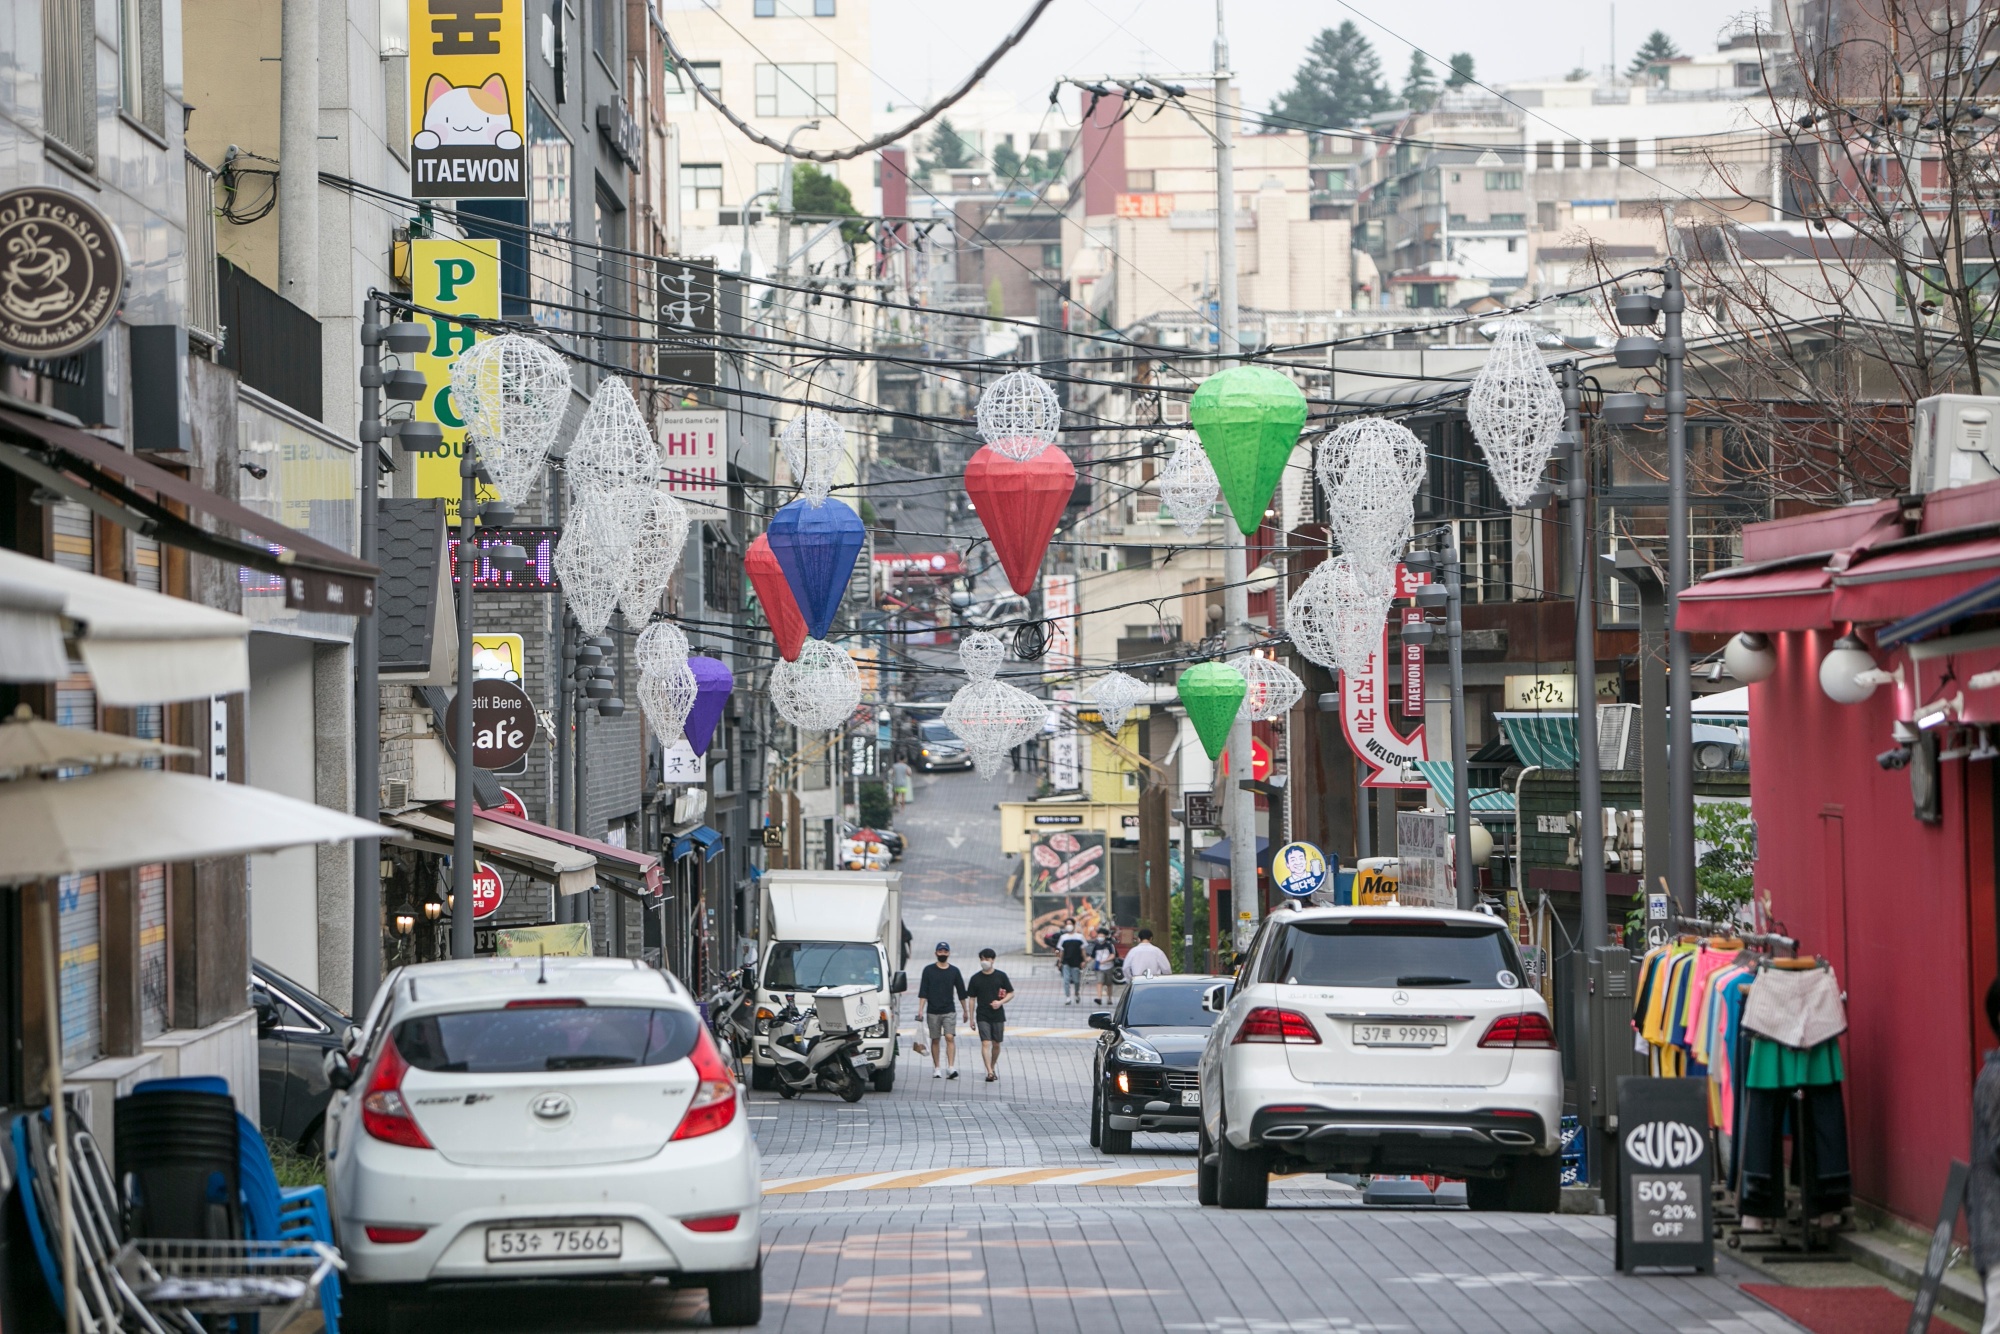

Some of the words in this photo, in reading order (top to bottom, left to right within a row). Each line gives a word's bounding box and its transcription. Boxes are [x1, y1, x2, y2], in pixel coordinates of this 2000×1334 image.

[417, 158, 519, 183] ITAEWON
[7, 318, 84, 345] Sandwich
[79, 285, 111, 329] Juice
[668, 431, 697, 456] Hi
[669, 467, 716, 491] Hill
[1408, 663, 1421, 711] ITAEWON
[472, 696, 488, 709] etit
[492, 696, 522, 709] Bene
[472, 716, 524, 749] afé
[1398, 1026, 1439, 1042] 9999
[1187, 1091, 1200, 1102] 20
[1638, 1180, 1688, 1201] 50%
[552, 1229, 609, 1251] 7566
[1651, 1221, 1684, 1237] OFF
